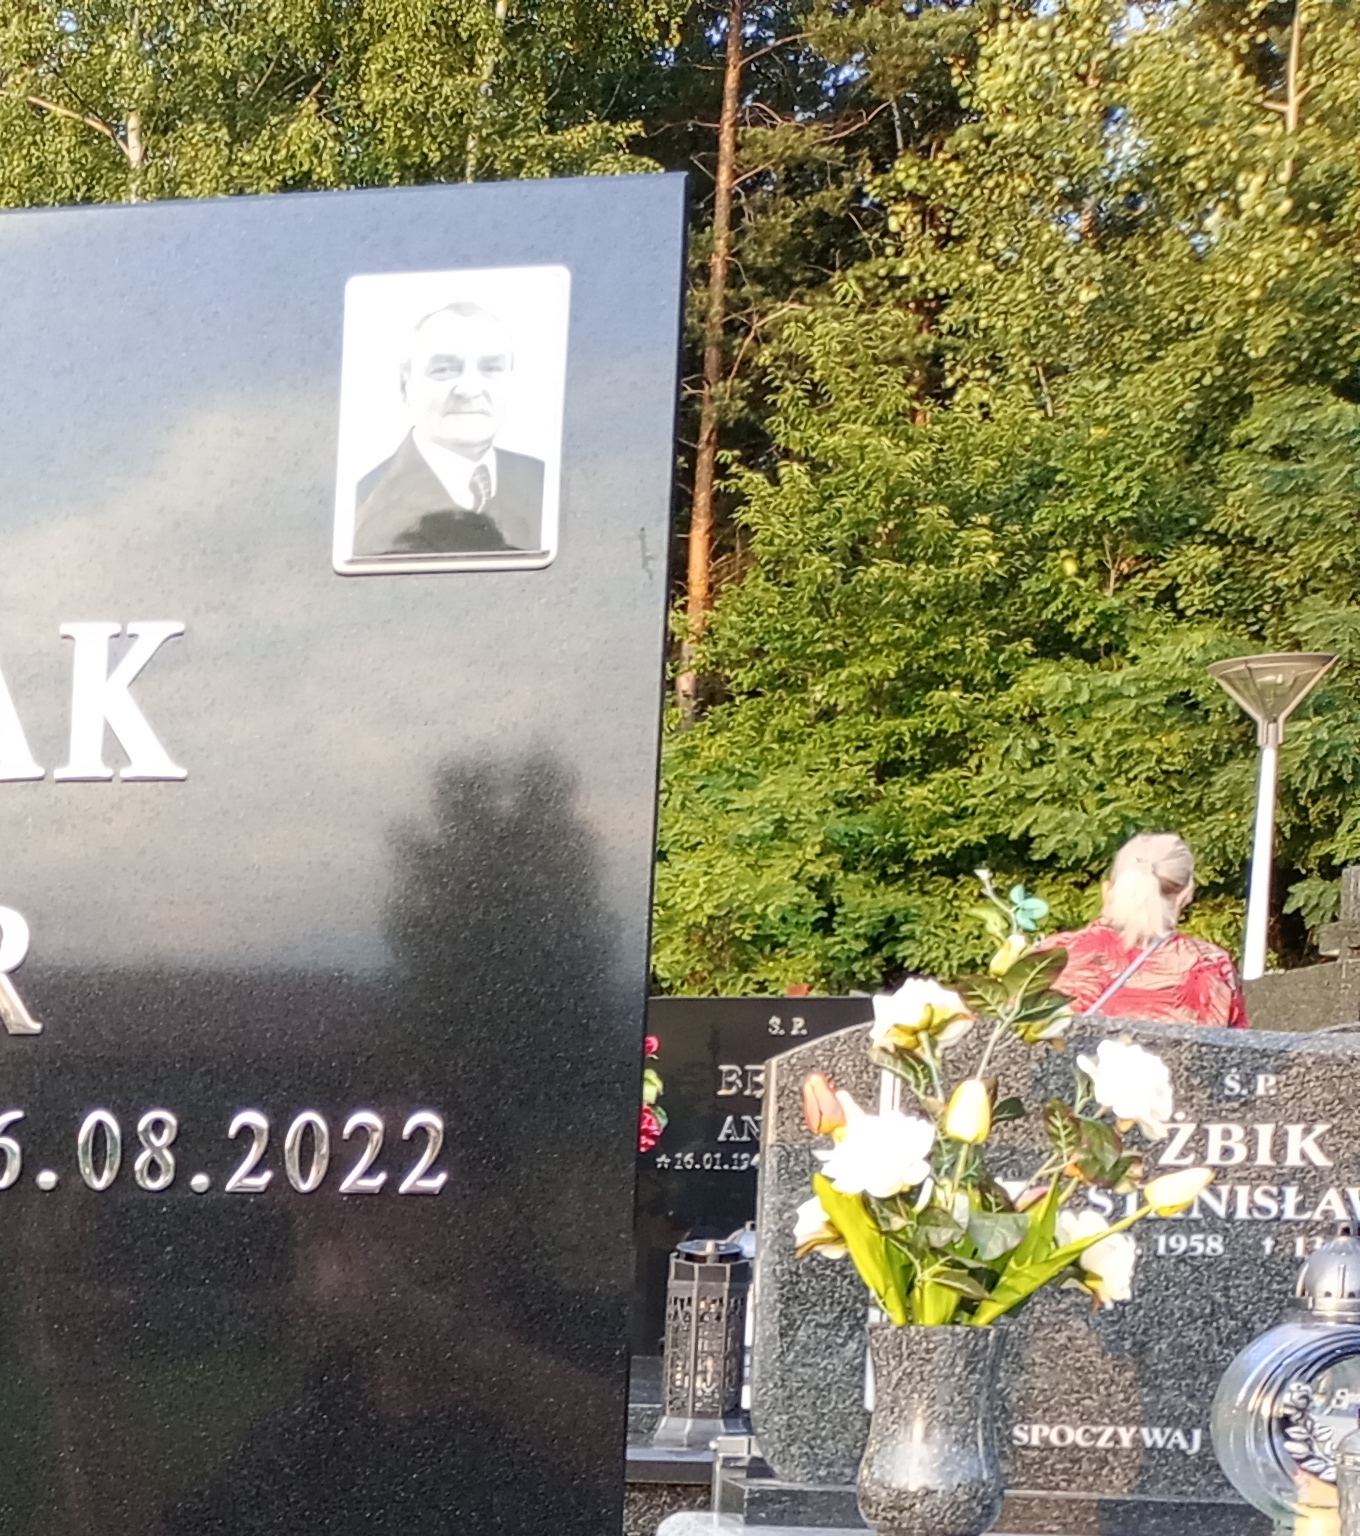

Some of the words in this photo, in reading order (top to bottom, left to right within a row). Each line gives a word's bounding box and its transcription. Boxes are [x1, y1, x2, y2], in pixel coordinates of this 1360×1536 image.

[1157, 1111, 1334, 1167] ŻBIK
[1087, 1183, 1360, 1221] STNISŁA
[1155, 1233, 1225, 1257] 1958
